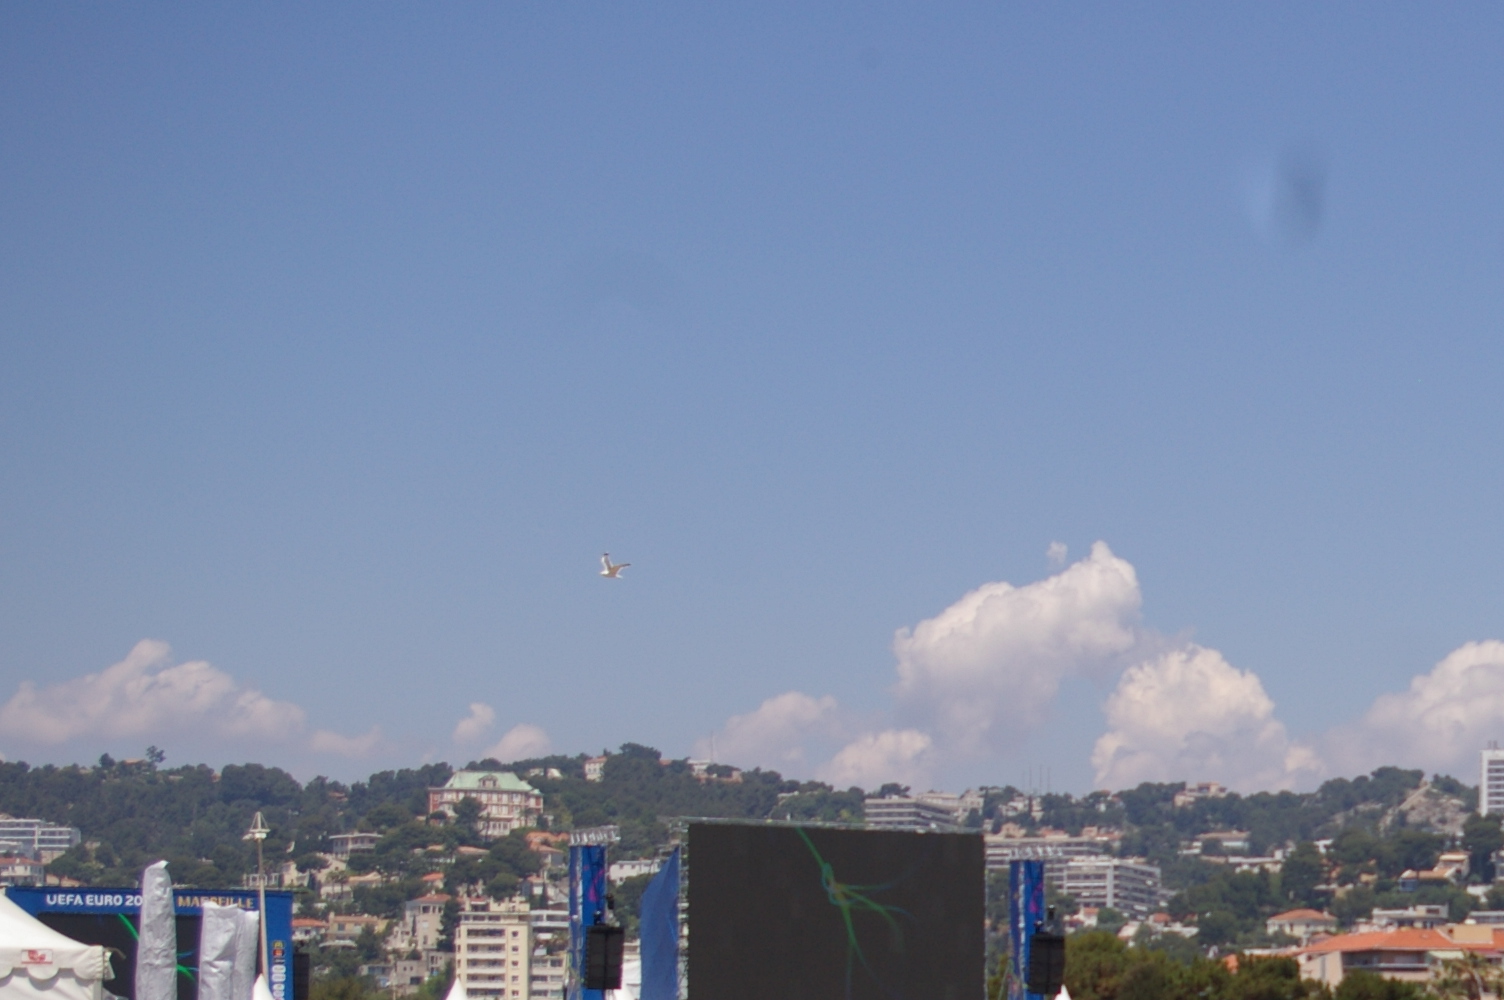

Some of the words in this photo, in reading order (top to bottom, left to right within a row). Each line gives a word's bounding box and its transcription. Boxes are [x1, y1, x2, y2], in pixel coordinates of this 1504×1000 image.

[46, 894, 84, 906] UEFA
[86, 894, 122, 906] EURO
[125, 894, 143, 906] 20
